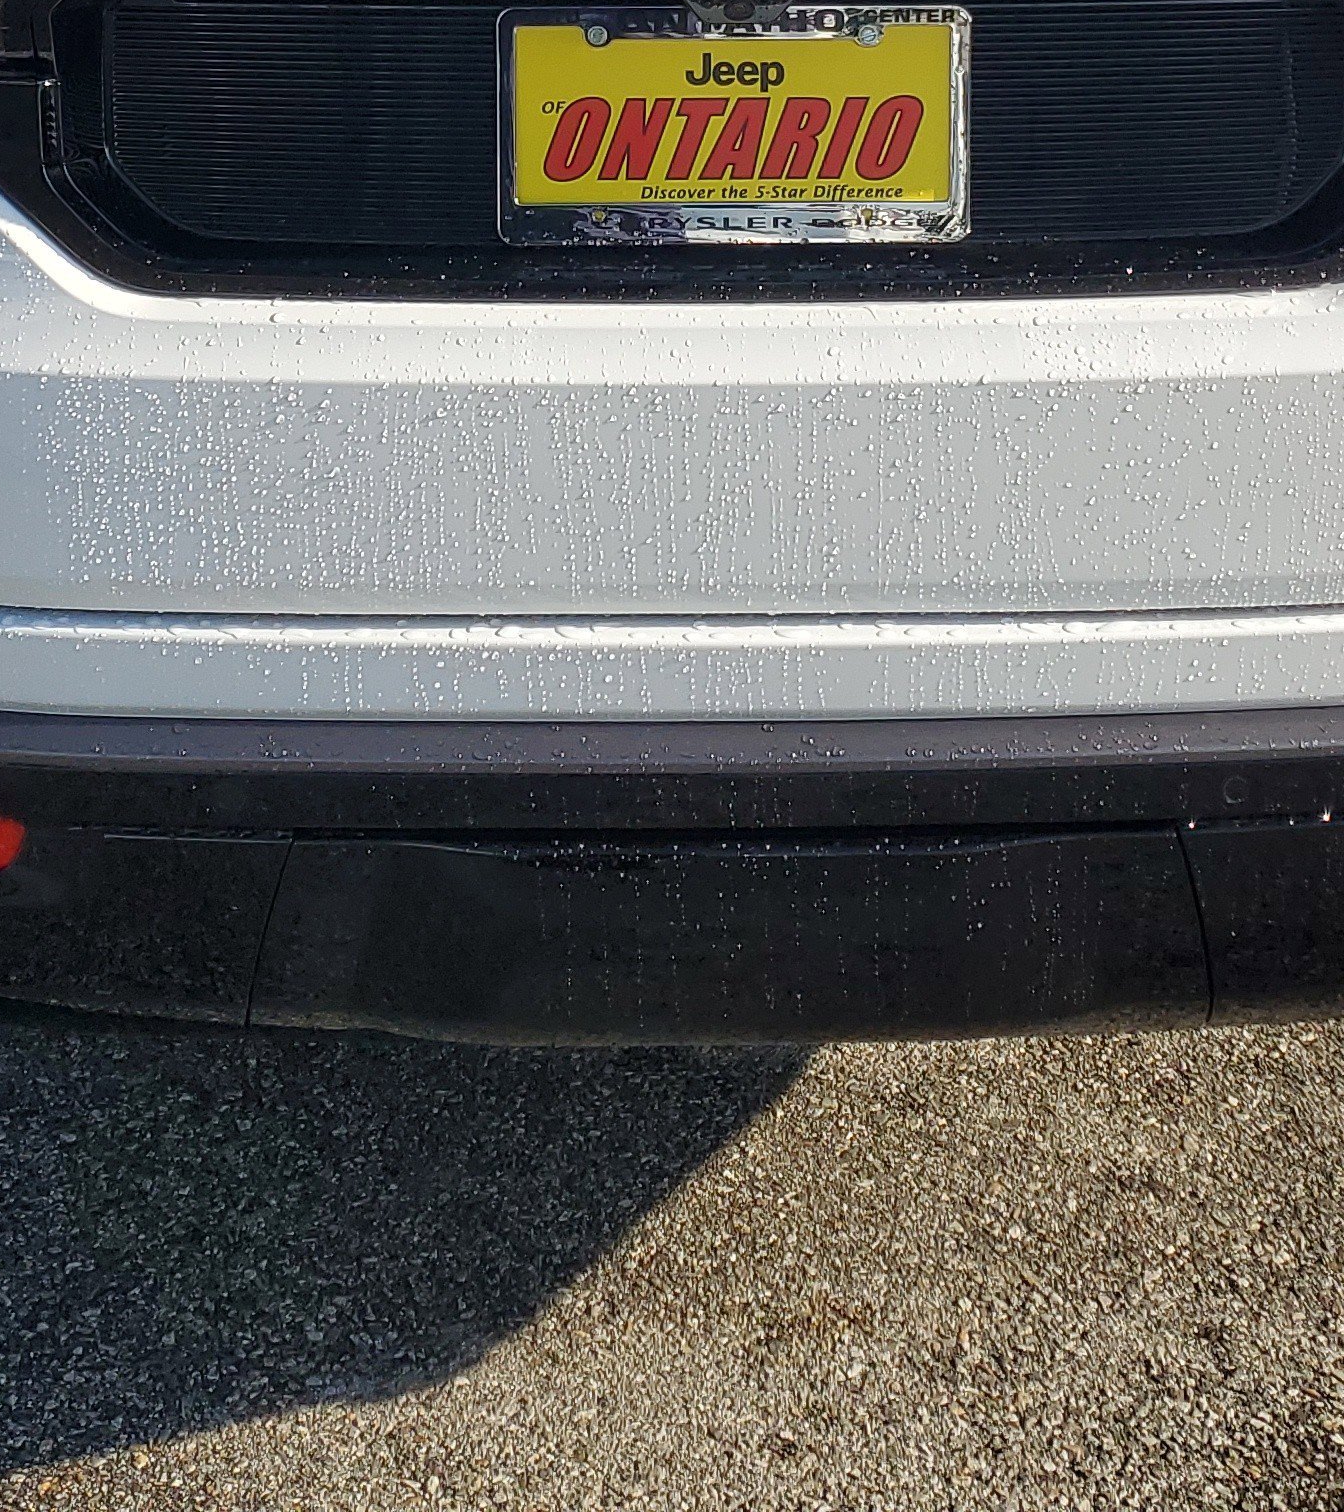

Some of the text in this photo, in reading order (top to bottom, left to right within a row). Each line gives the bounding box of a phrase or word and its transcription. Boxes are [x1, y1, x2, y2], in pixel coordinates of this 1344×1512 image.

[862, 8, 955, 24] CENTER
[685, 52, 785, 92] Jeep
[542, 95, 924, 182] OF ONTARIO
[640, 185, 904, 202] Discover the 5-Star Difference
[593, 216, 794, 230] CRYSLER
